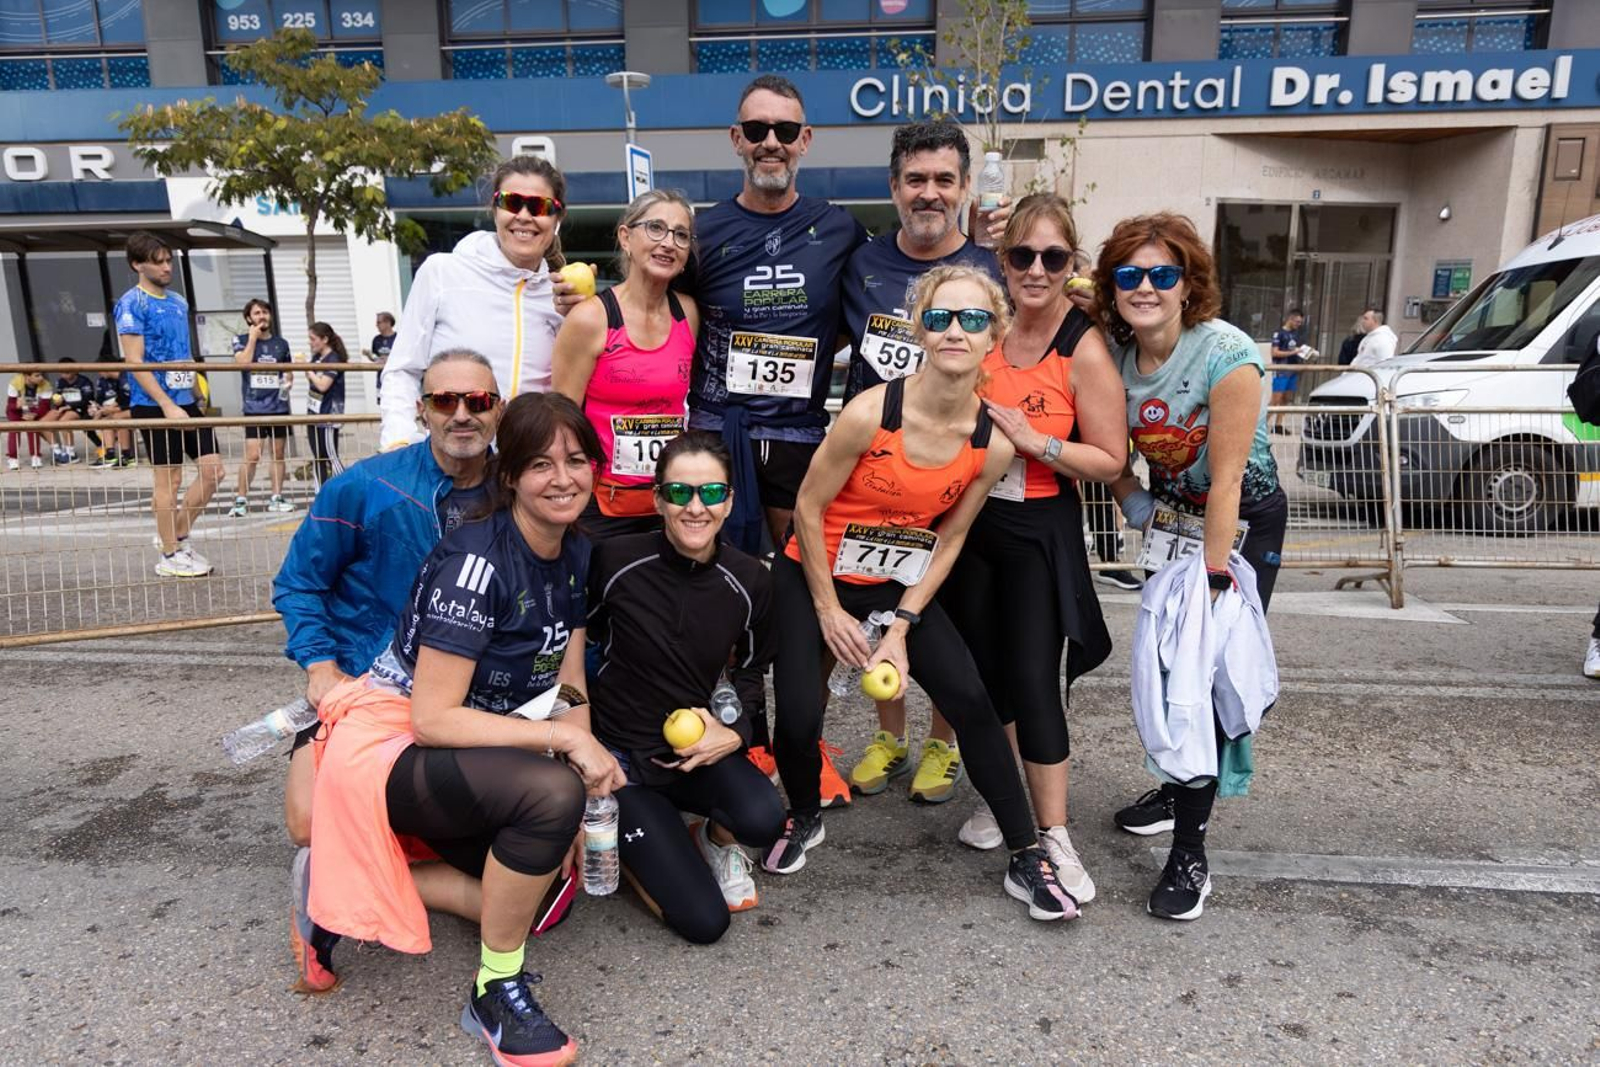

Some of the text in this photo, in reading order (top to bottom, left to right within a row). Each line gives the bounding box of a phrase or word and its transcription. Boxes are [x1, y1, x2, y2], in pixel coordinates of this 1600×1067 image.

[227, 12, 375, 30] 953 225 334
[1064, 66, 1242, 113] Dental
[1269, 66, 1353, 107] Dr.
[1366, 55, 1573, 104] Ismael
[744, 264, 805, 290] 25
[744, 289, 806, 299] CARRERA
[744, 296, 808, 306] POPULAR
[871, 317, 892, 330] XXV
[734, 335, 754, 347] XXV
[877, 342, 925, 372] 591
[256, 376, 275, 385] 615
[748, 359, 796, 384] 135
[633, 440, 672, 462] 10
[1155, 510, 1176, 525] XXV
[849, 524, 871, 535] XXV
[857, 544, 912, 568] 717
[428, 588, 495, 632] Rotalaya
[538, 621, 570, 656] 25
[488, 670, 511, 687] IES
